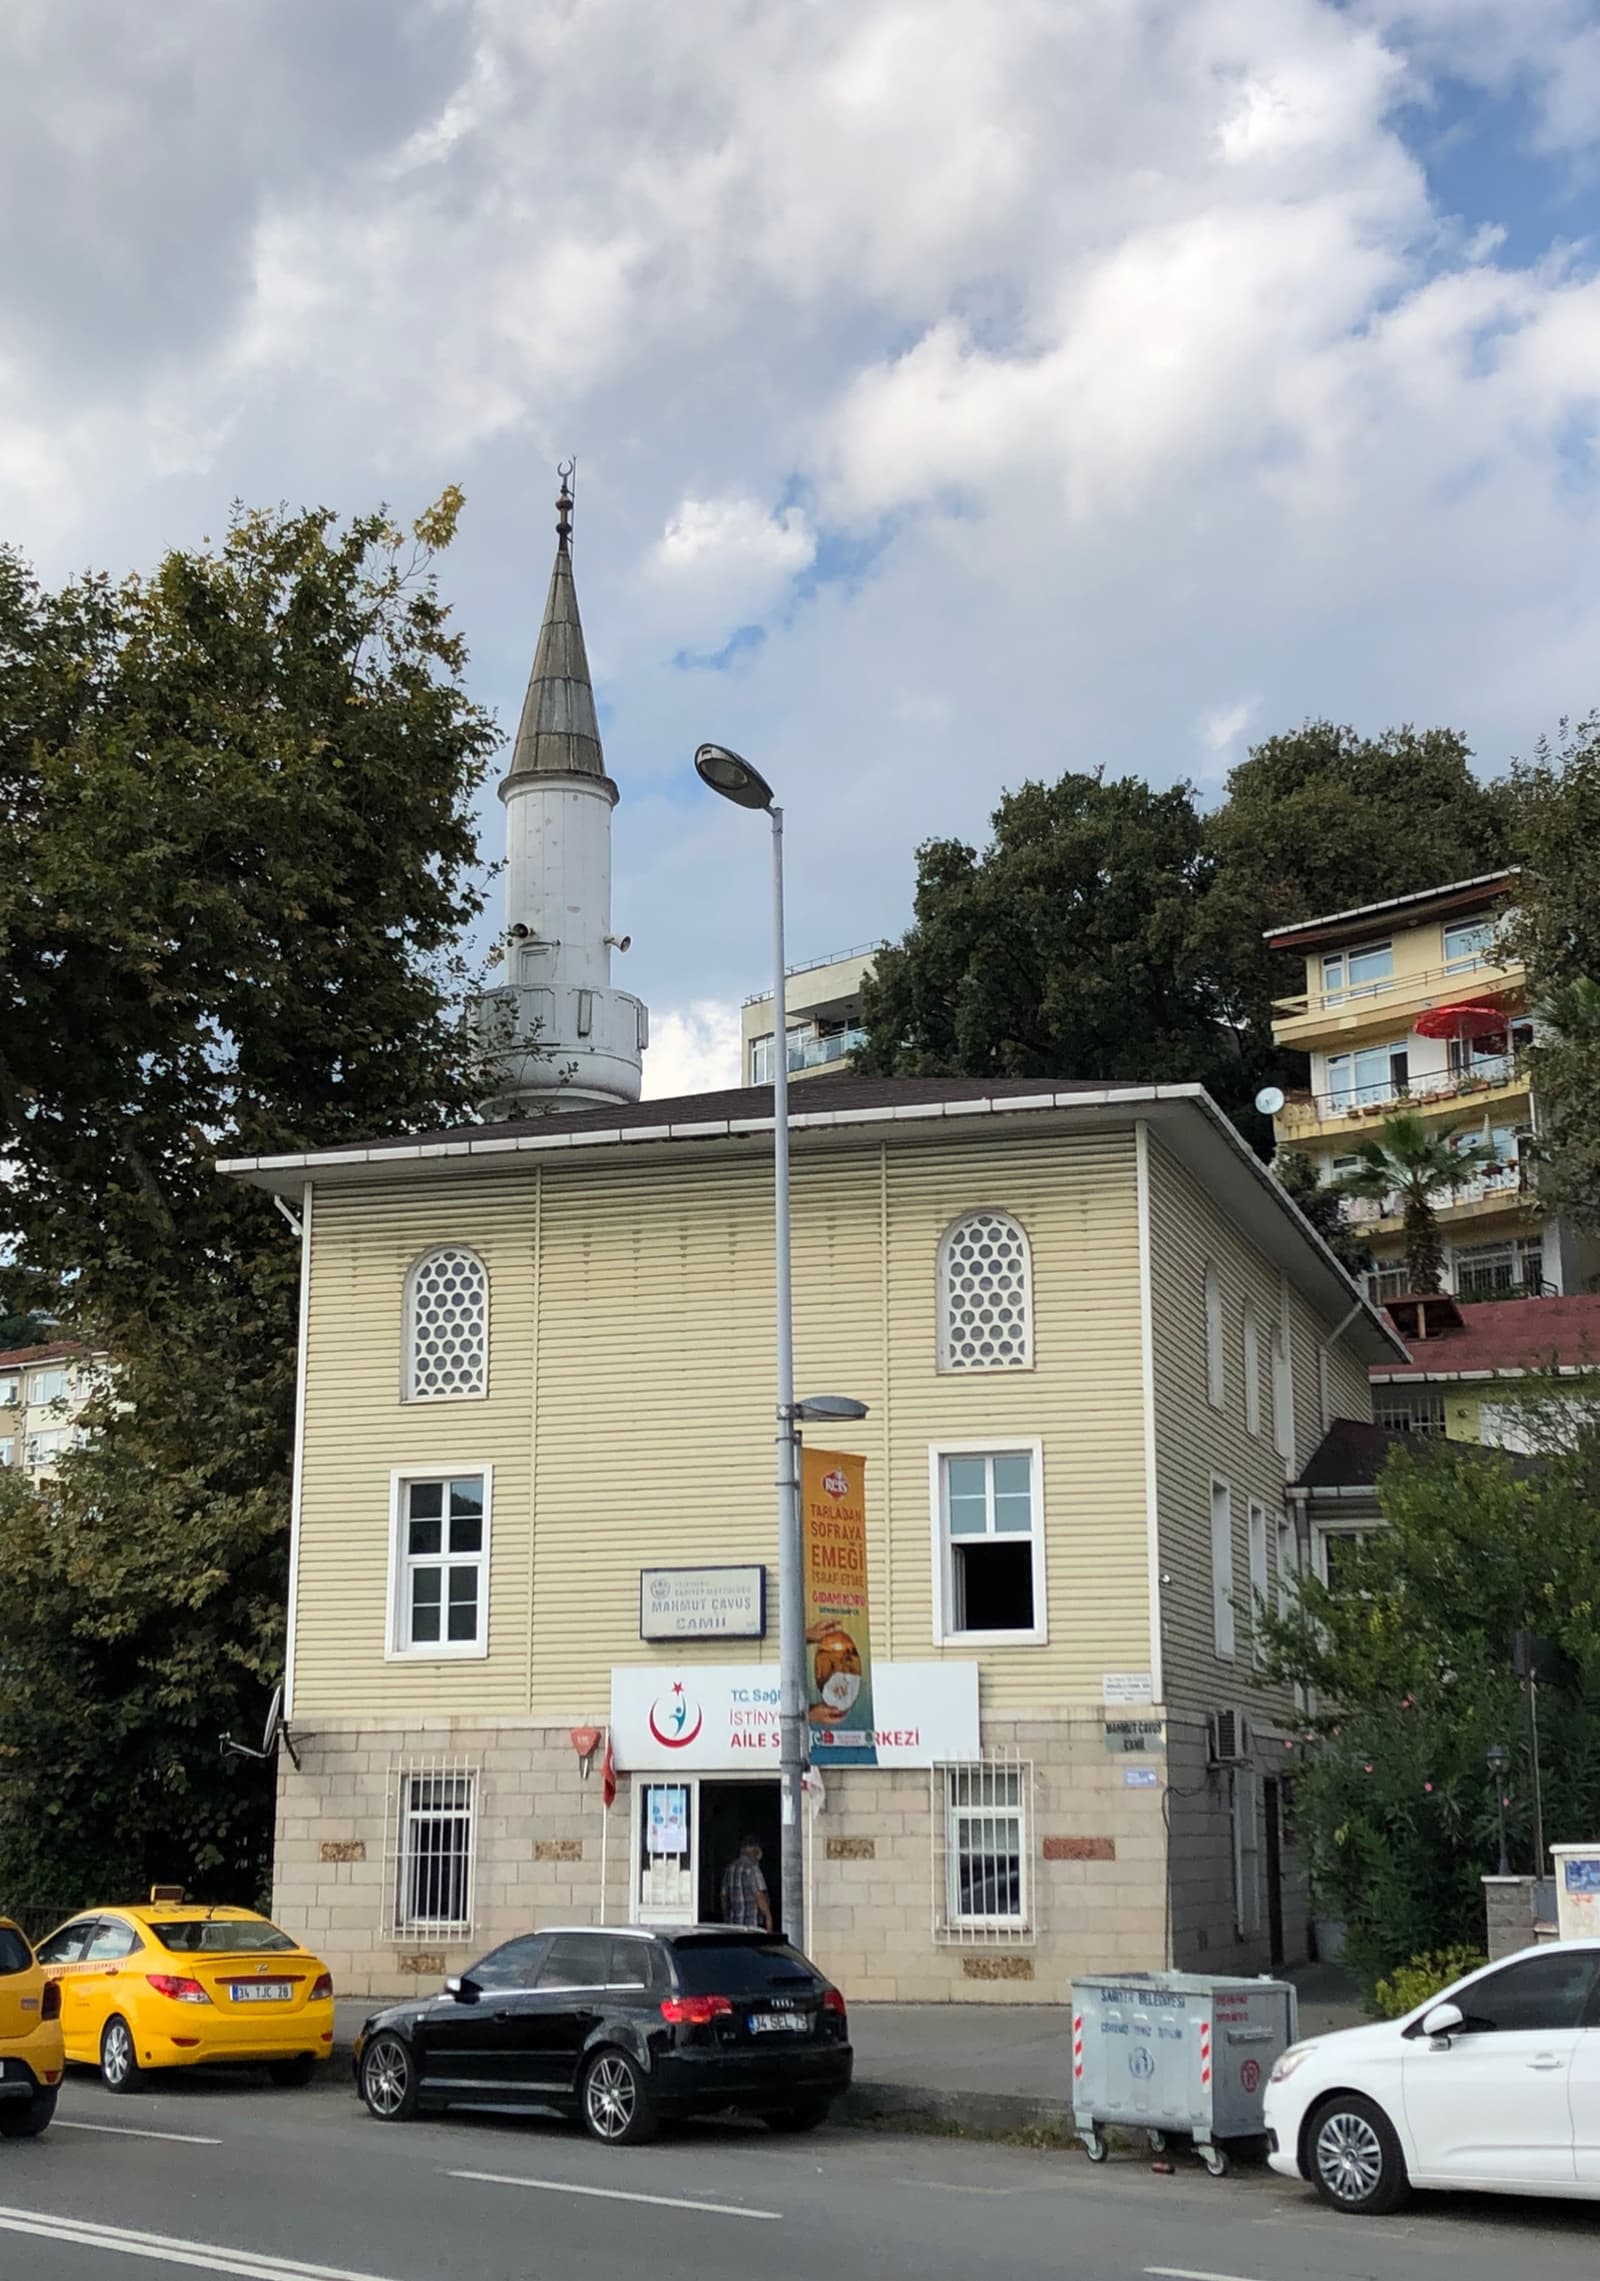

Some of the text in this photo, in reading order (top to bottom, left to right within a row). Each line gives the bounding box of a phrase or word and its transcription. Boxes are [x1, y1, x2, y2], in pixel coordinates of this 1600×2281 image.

[811, 1520, 863, 1541] SOFRAYA
[812, 1541, 864, 1571] EMEĞİ
[651, 1598, 706, 1613] MAHMUT
[729, 1707, 781, 1726] İSTİNY
[730, 1729, 767, 1748] AİLE
